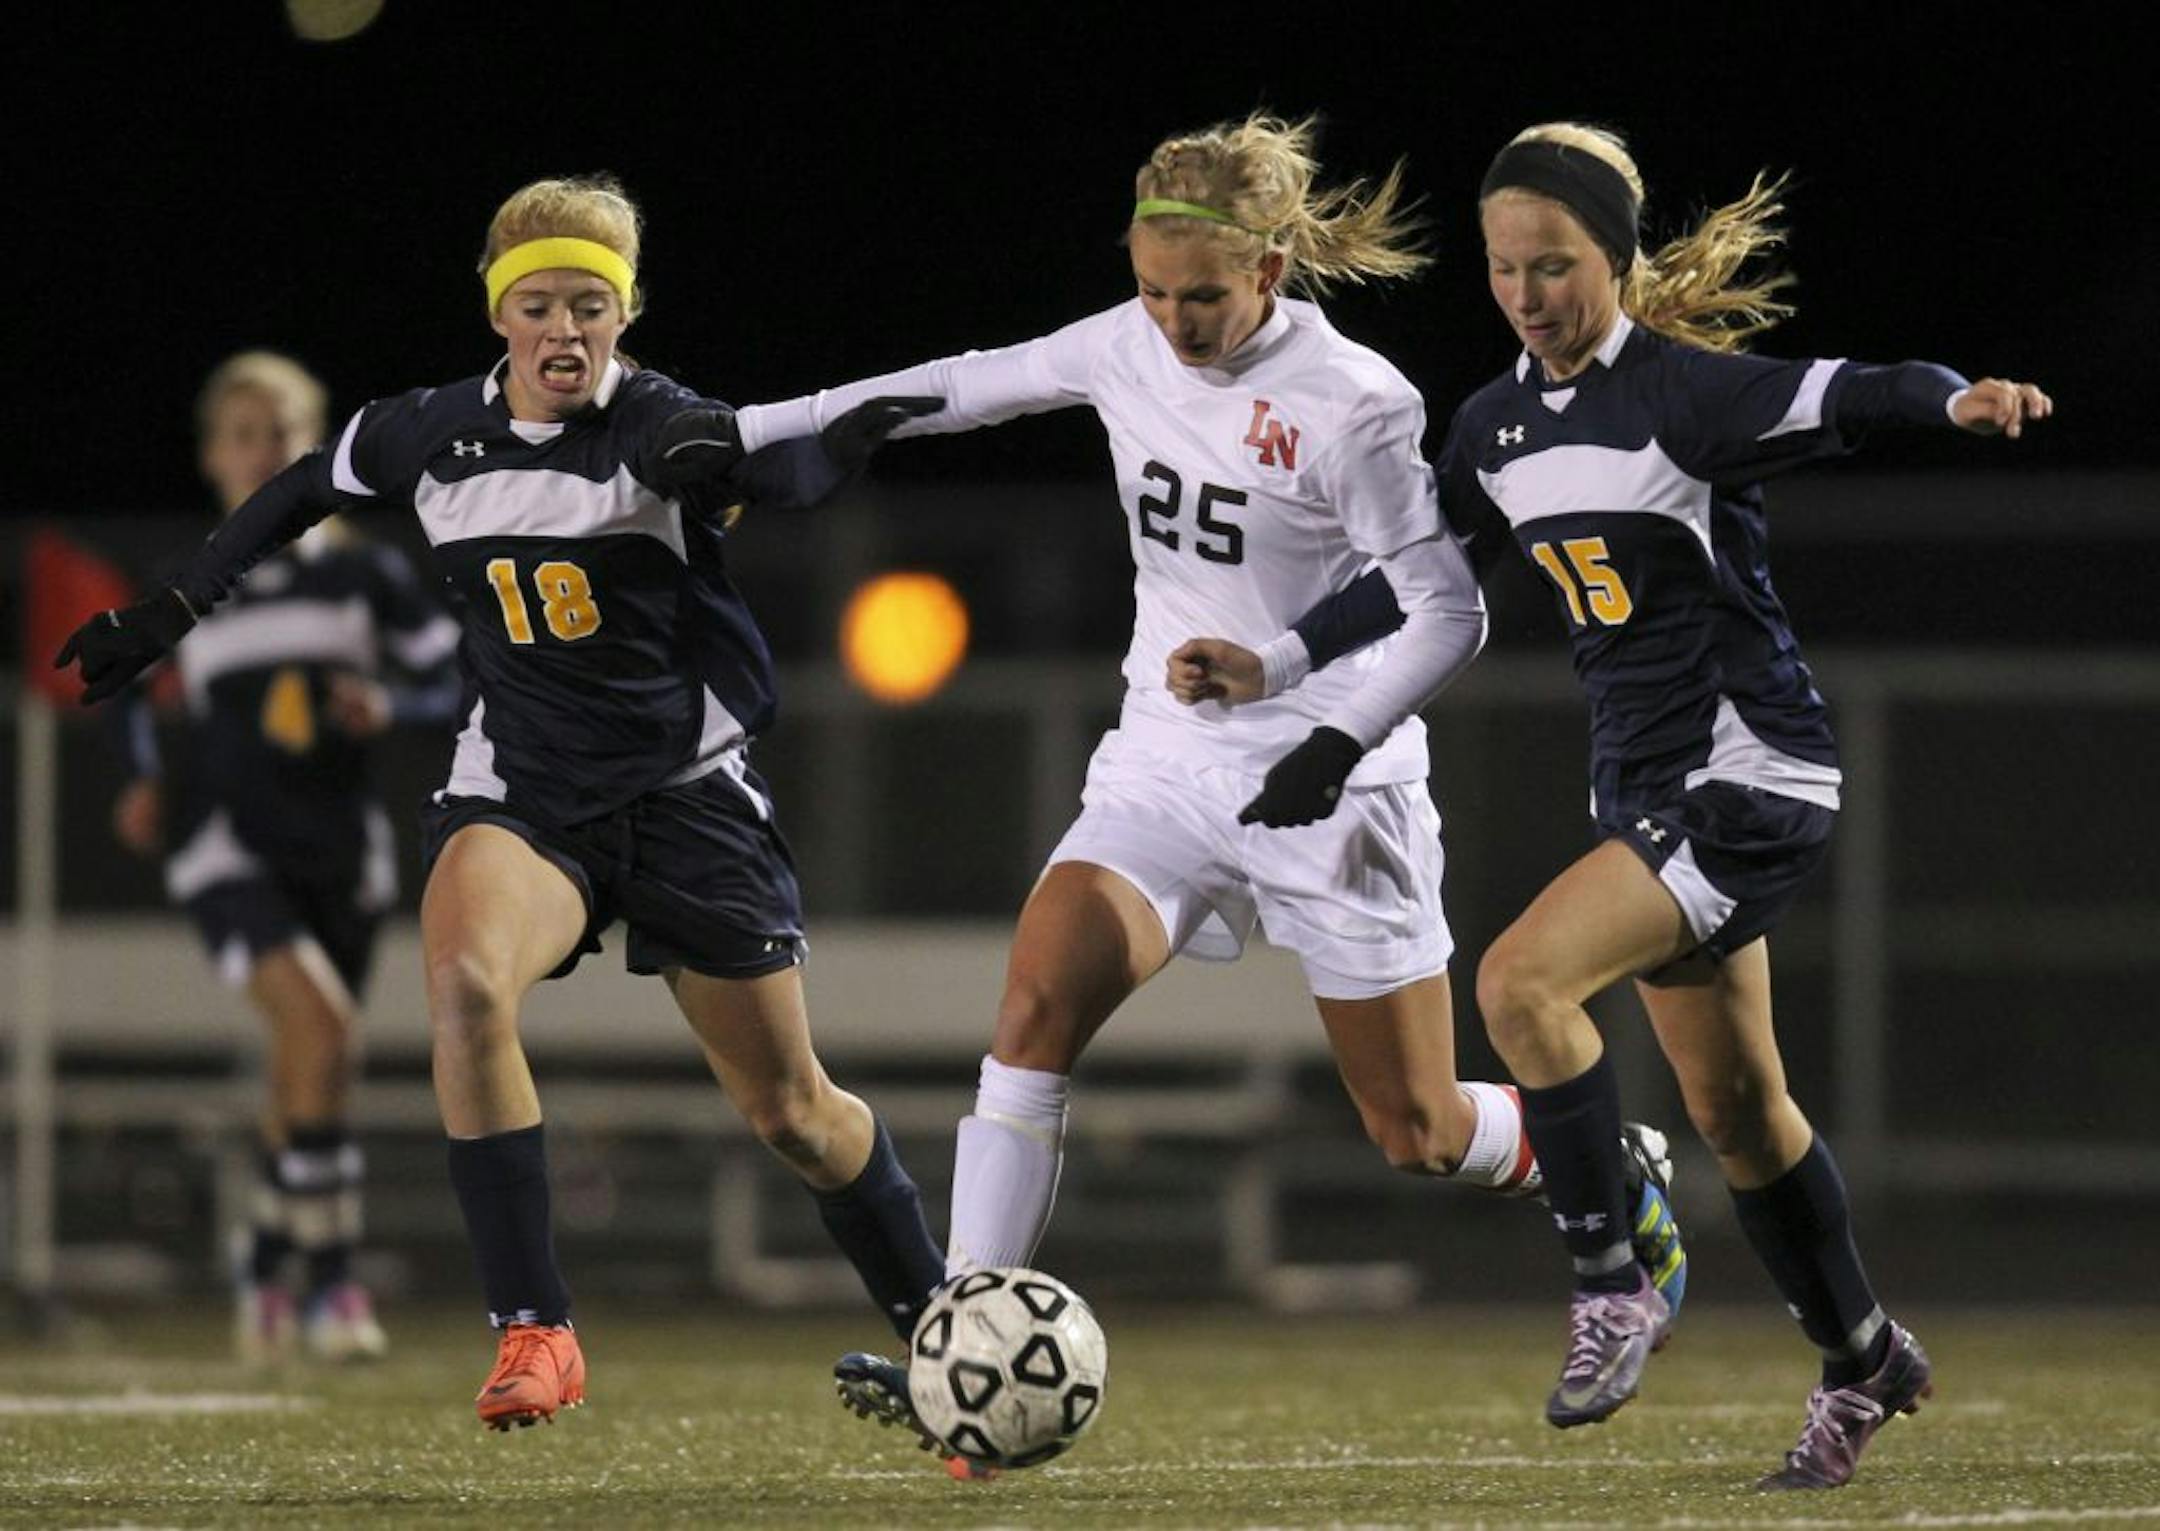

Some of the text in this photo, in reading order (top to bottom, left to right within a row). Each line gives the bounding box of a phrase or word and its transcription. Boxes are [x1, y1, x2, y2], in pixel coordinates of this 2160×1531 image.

[1244, 400, 1300, 470] LN
[1139, 459, 1248, 565] 25
[486, 558, 602, 644] 18
[1531, 536, 1633, 625] 15
